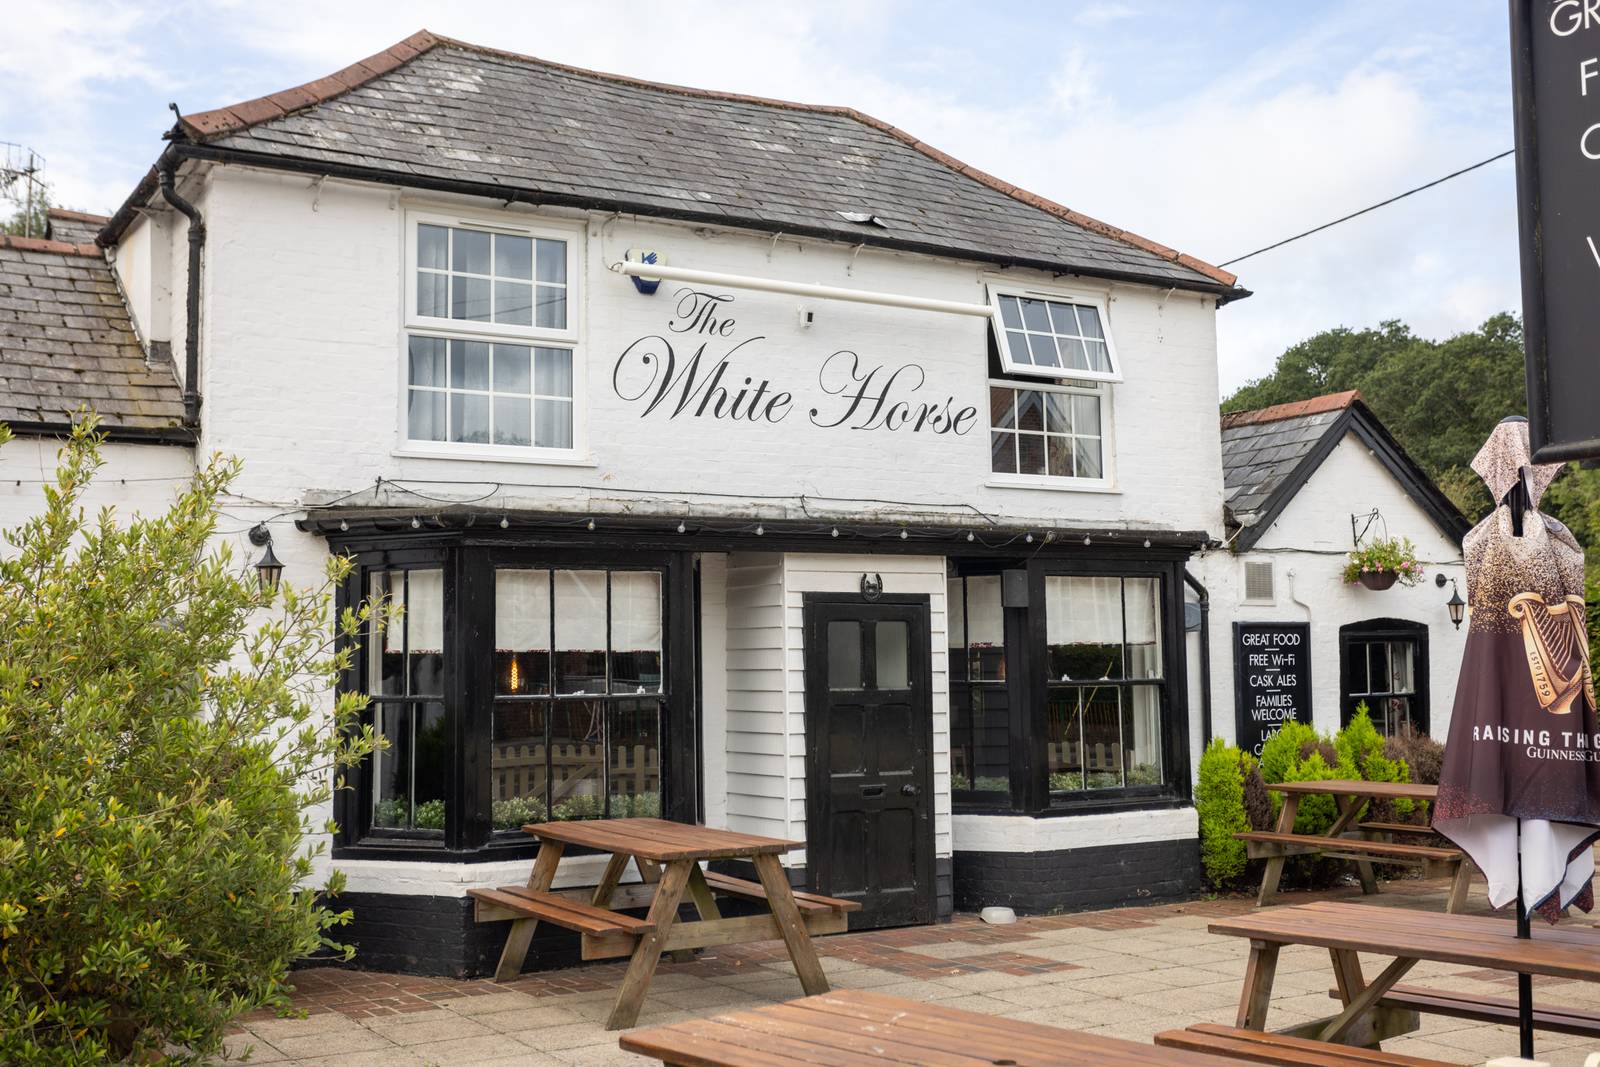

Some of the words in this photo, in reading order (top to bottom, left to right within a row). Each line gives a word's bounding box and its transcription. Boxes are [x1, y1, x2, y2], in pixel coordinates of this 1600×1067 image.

[668, 287, 736, 337] The
[612, 335, 794, 424] White
[808, 350, 978, 436] Horse
[1242, 633, 1271, 646] GREAT
[1273, 633, 1301, 646] FOOD
[1249, 654, 1269, 667] FREE
[1271, 654, 1296, 666] Wi-Fi
[1249, 674, 1274, 687] CASK
[1276, 674, 1297, 687] ALES
[1535, 672, 1551, 697] 1759
[1255, 694, 1293, 707] FAMILIES
[1251, 708, 1297, 721] WELCOME
[1473, 724, 1551, 747] RAISING
